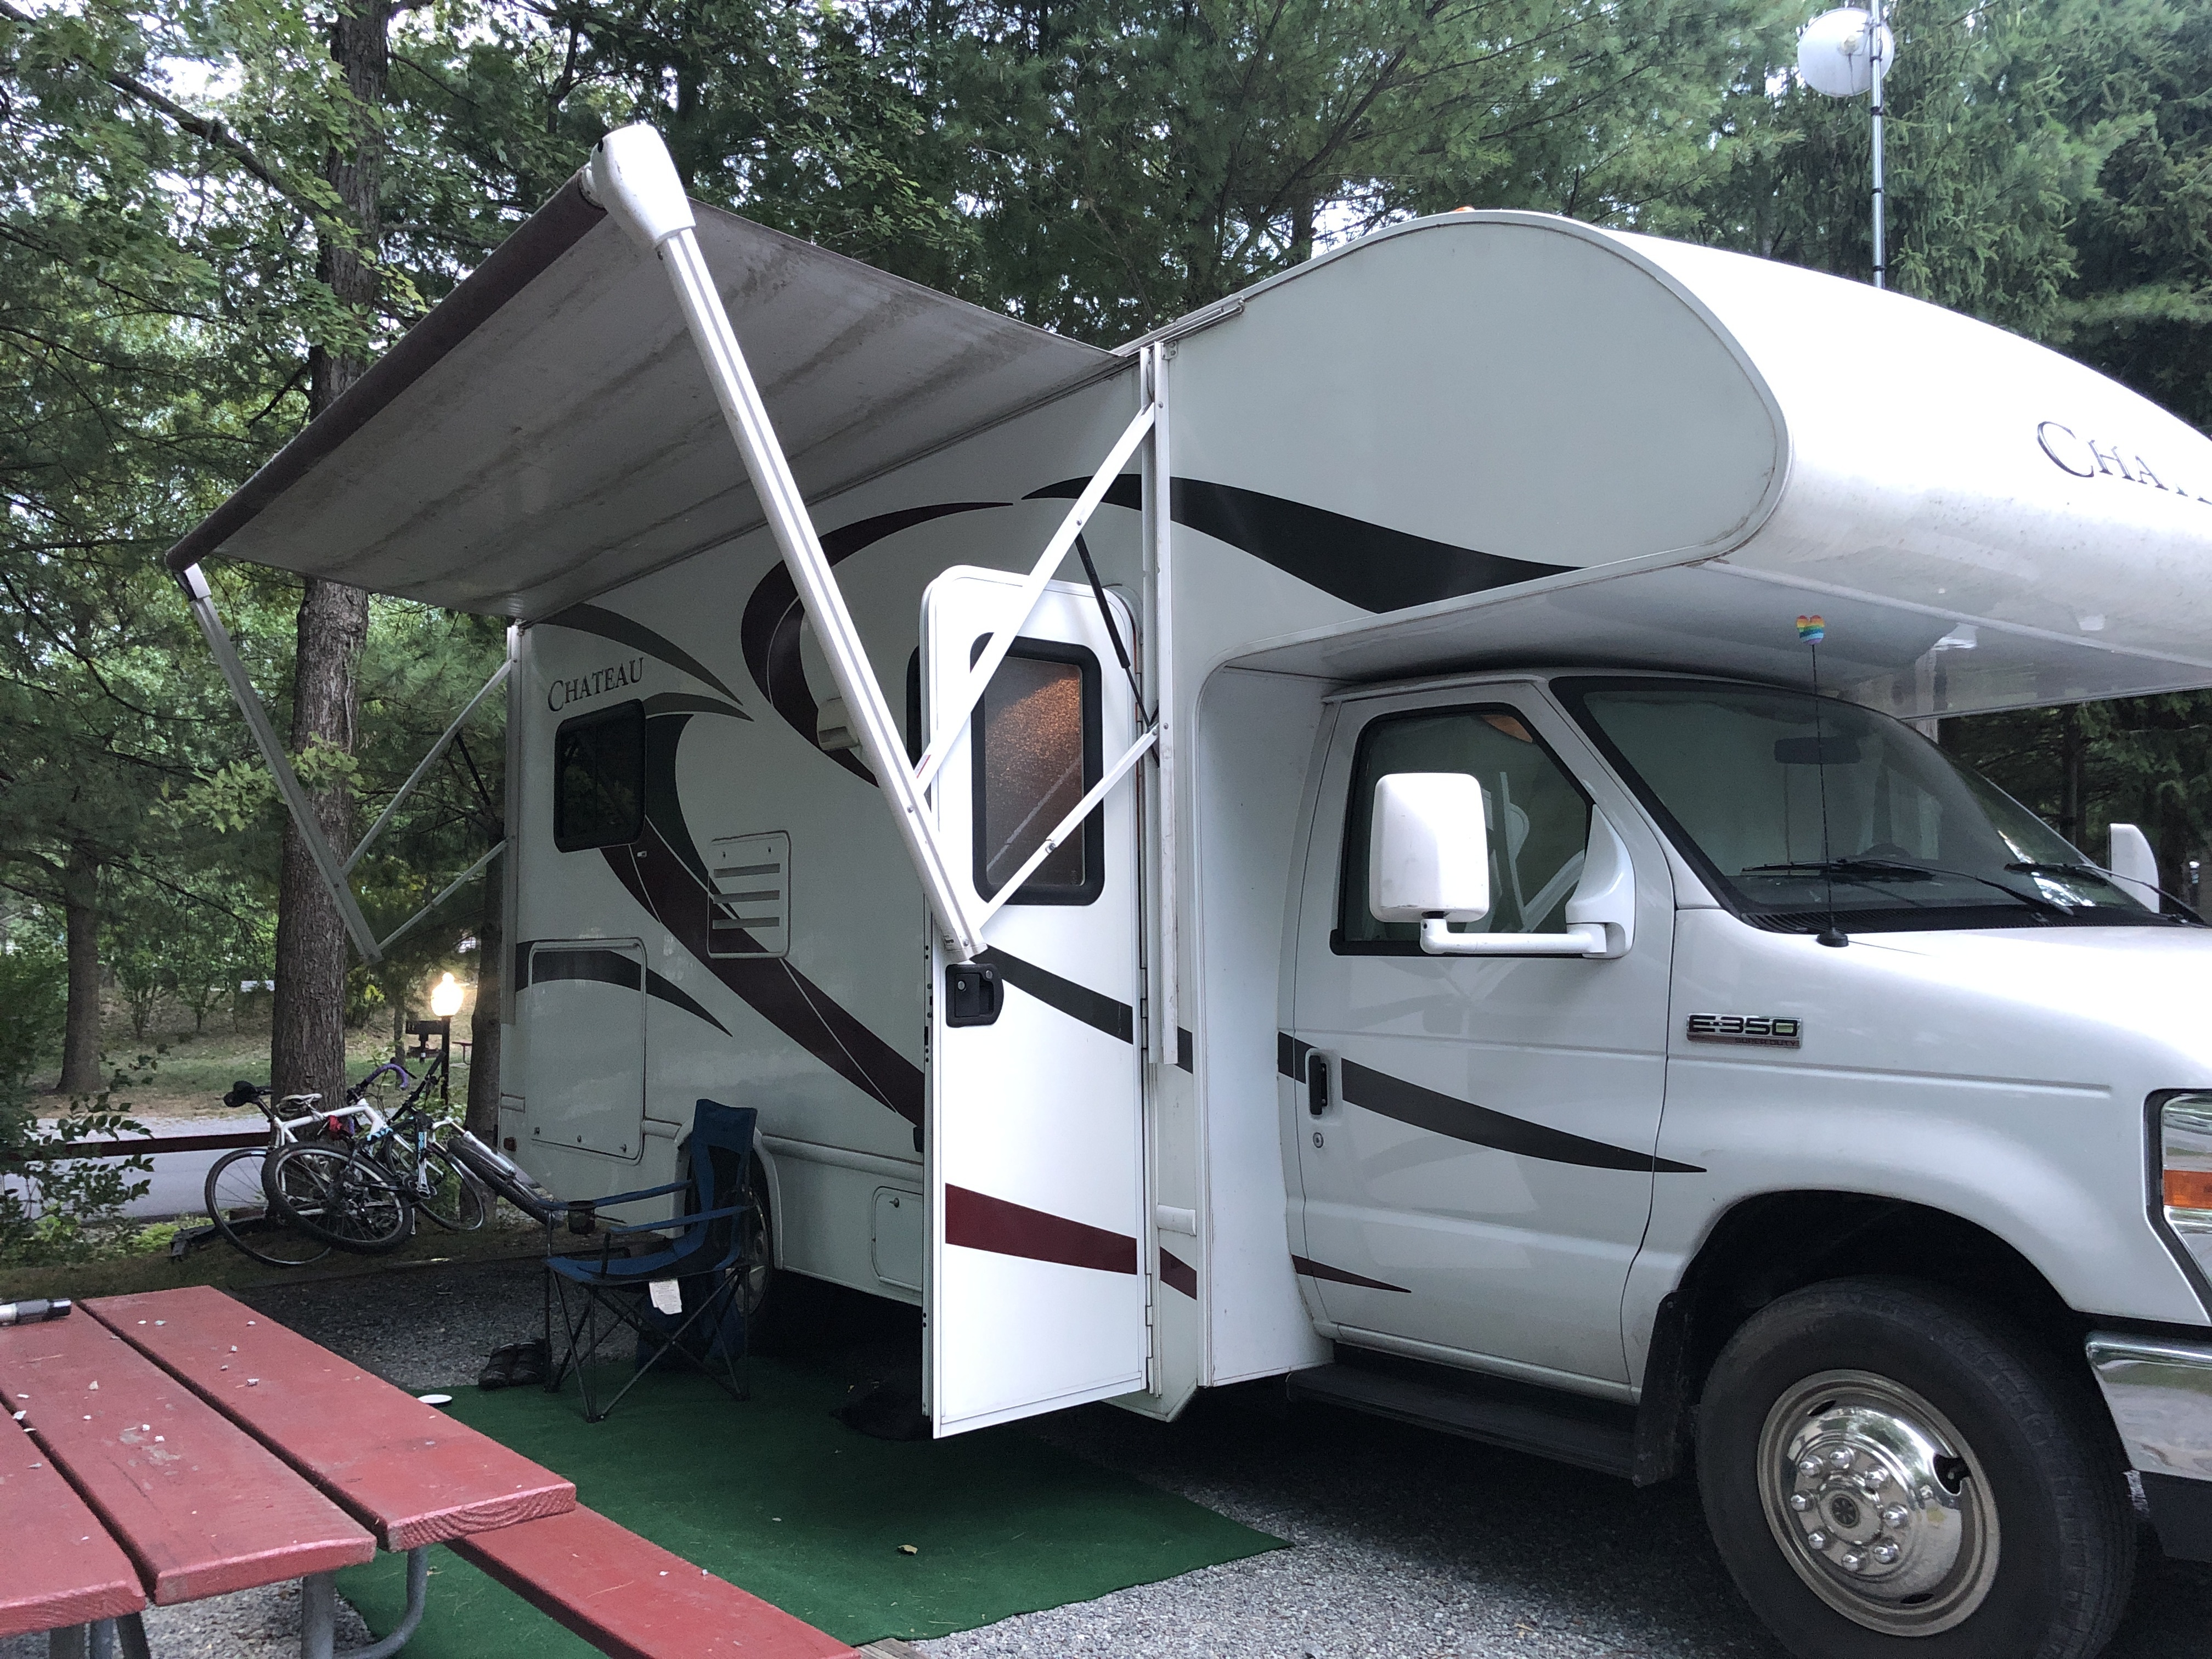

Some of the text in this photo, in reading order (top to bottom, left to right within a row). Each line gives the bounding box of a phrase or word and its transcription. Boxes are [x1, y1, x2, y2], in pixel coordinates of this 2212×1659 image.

[2036, 421, 2212, 505] CHA
[548, 657, 644, 712] CHATEAU
[1735, 1036, 1767, 1045] SUPER
